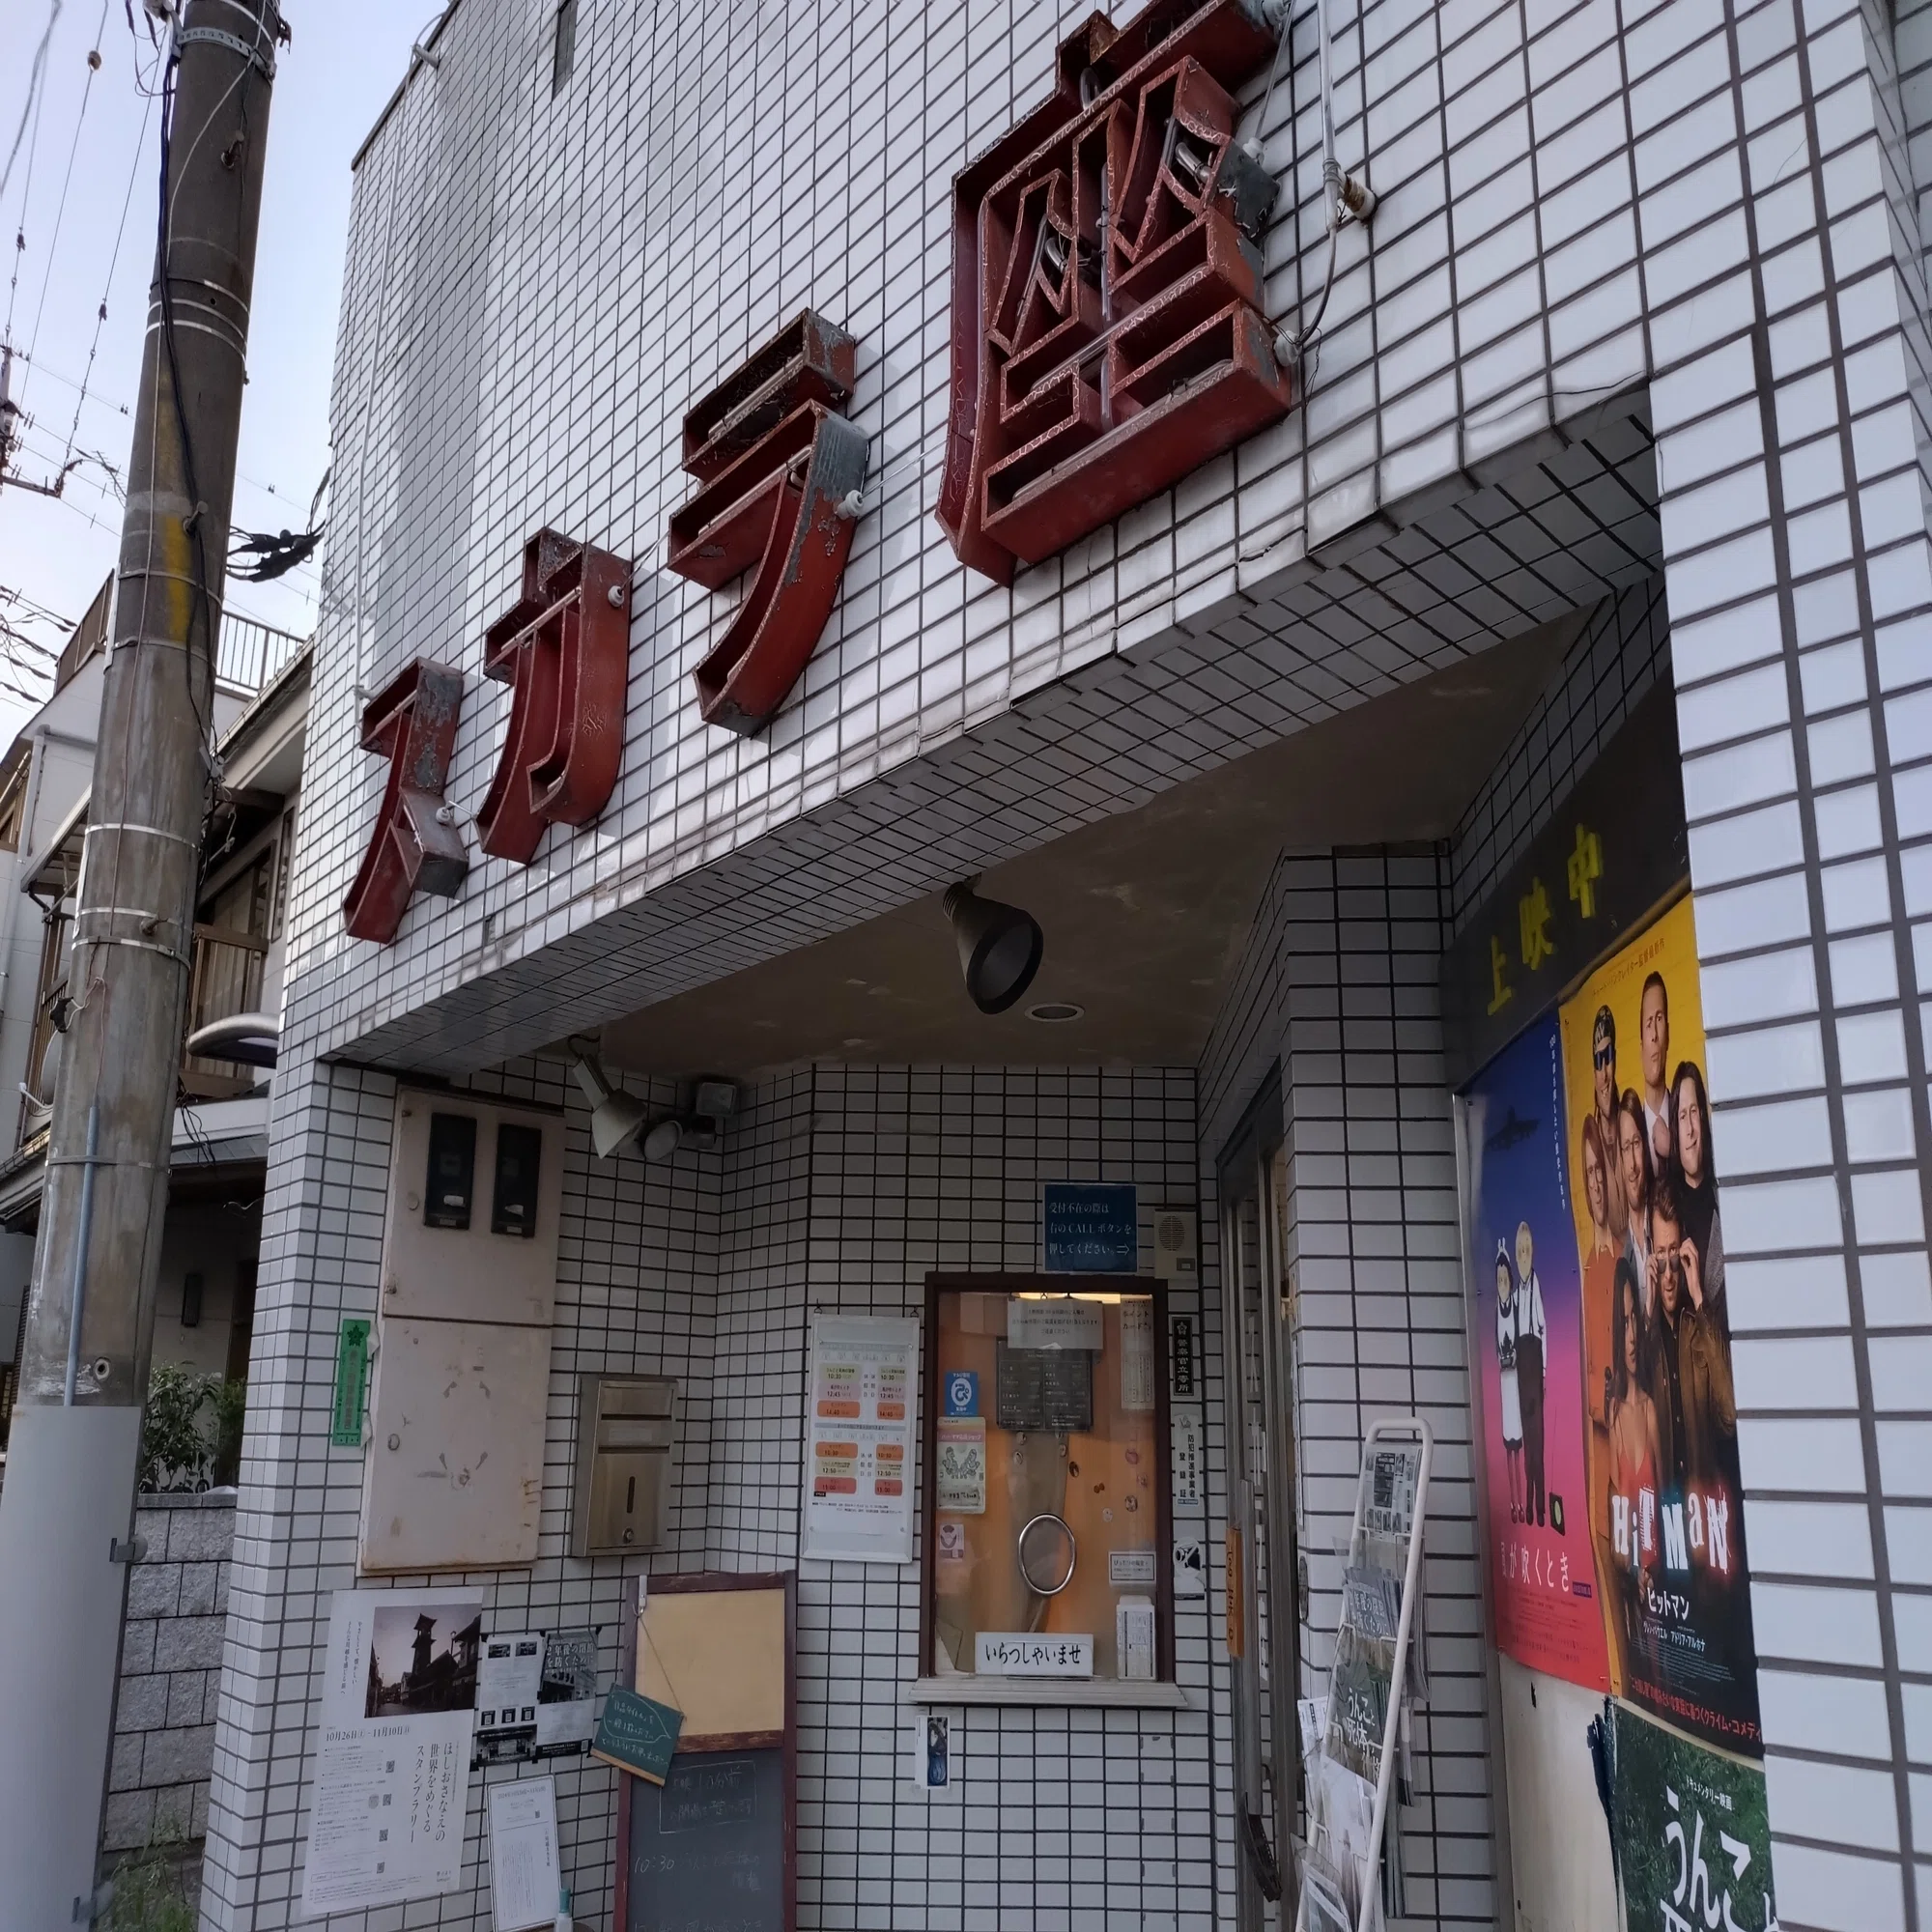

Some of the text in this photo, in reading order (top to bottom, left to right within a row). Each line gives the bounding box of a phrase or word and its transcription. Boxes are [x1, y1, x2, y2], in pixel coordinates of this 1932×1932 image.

[344, 0, 1293, 944] スカラ座
[1487, 822, 1605, 1016] 上映中
[1048, 1202, 1110, 1214] 受付不在の際は
[1177, 1339, 1190, 1392] 警察官立寄所
[1179, 1452, 1187, 1497] 登録証
[1187, 1434, 1196, 1497] 防犯推進事業者
[1501, 1542, 1569, 1592] 風が吹くとき
[1647, 1586, 1690, 1621] ヒットマン
[1348, 1687, 1376, 1726] うんこと
[410, 1745, 425, 1844] スタンプラリー
[423, 1743, 440, 1833] 世界をめぐる
[435, 1742, 453, 1842] ほしおさなえの
[1686, 1775, 1733, 1812] ドキュメンタリー映画
[635, 1855, 675, 1874] 10:30
